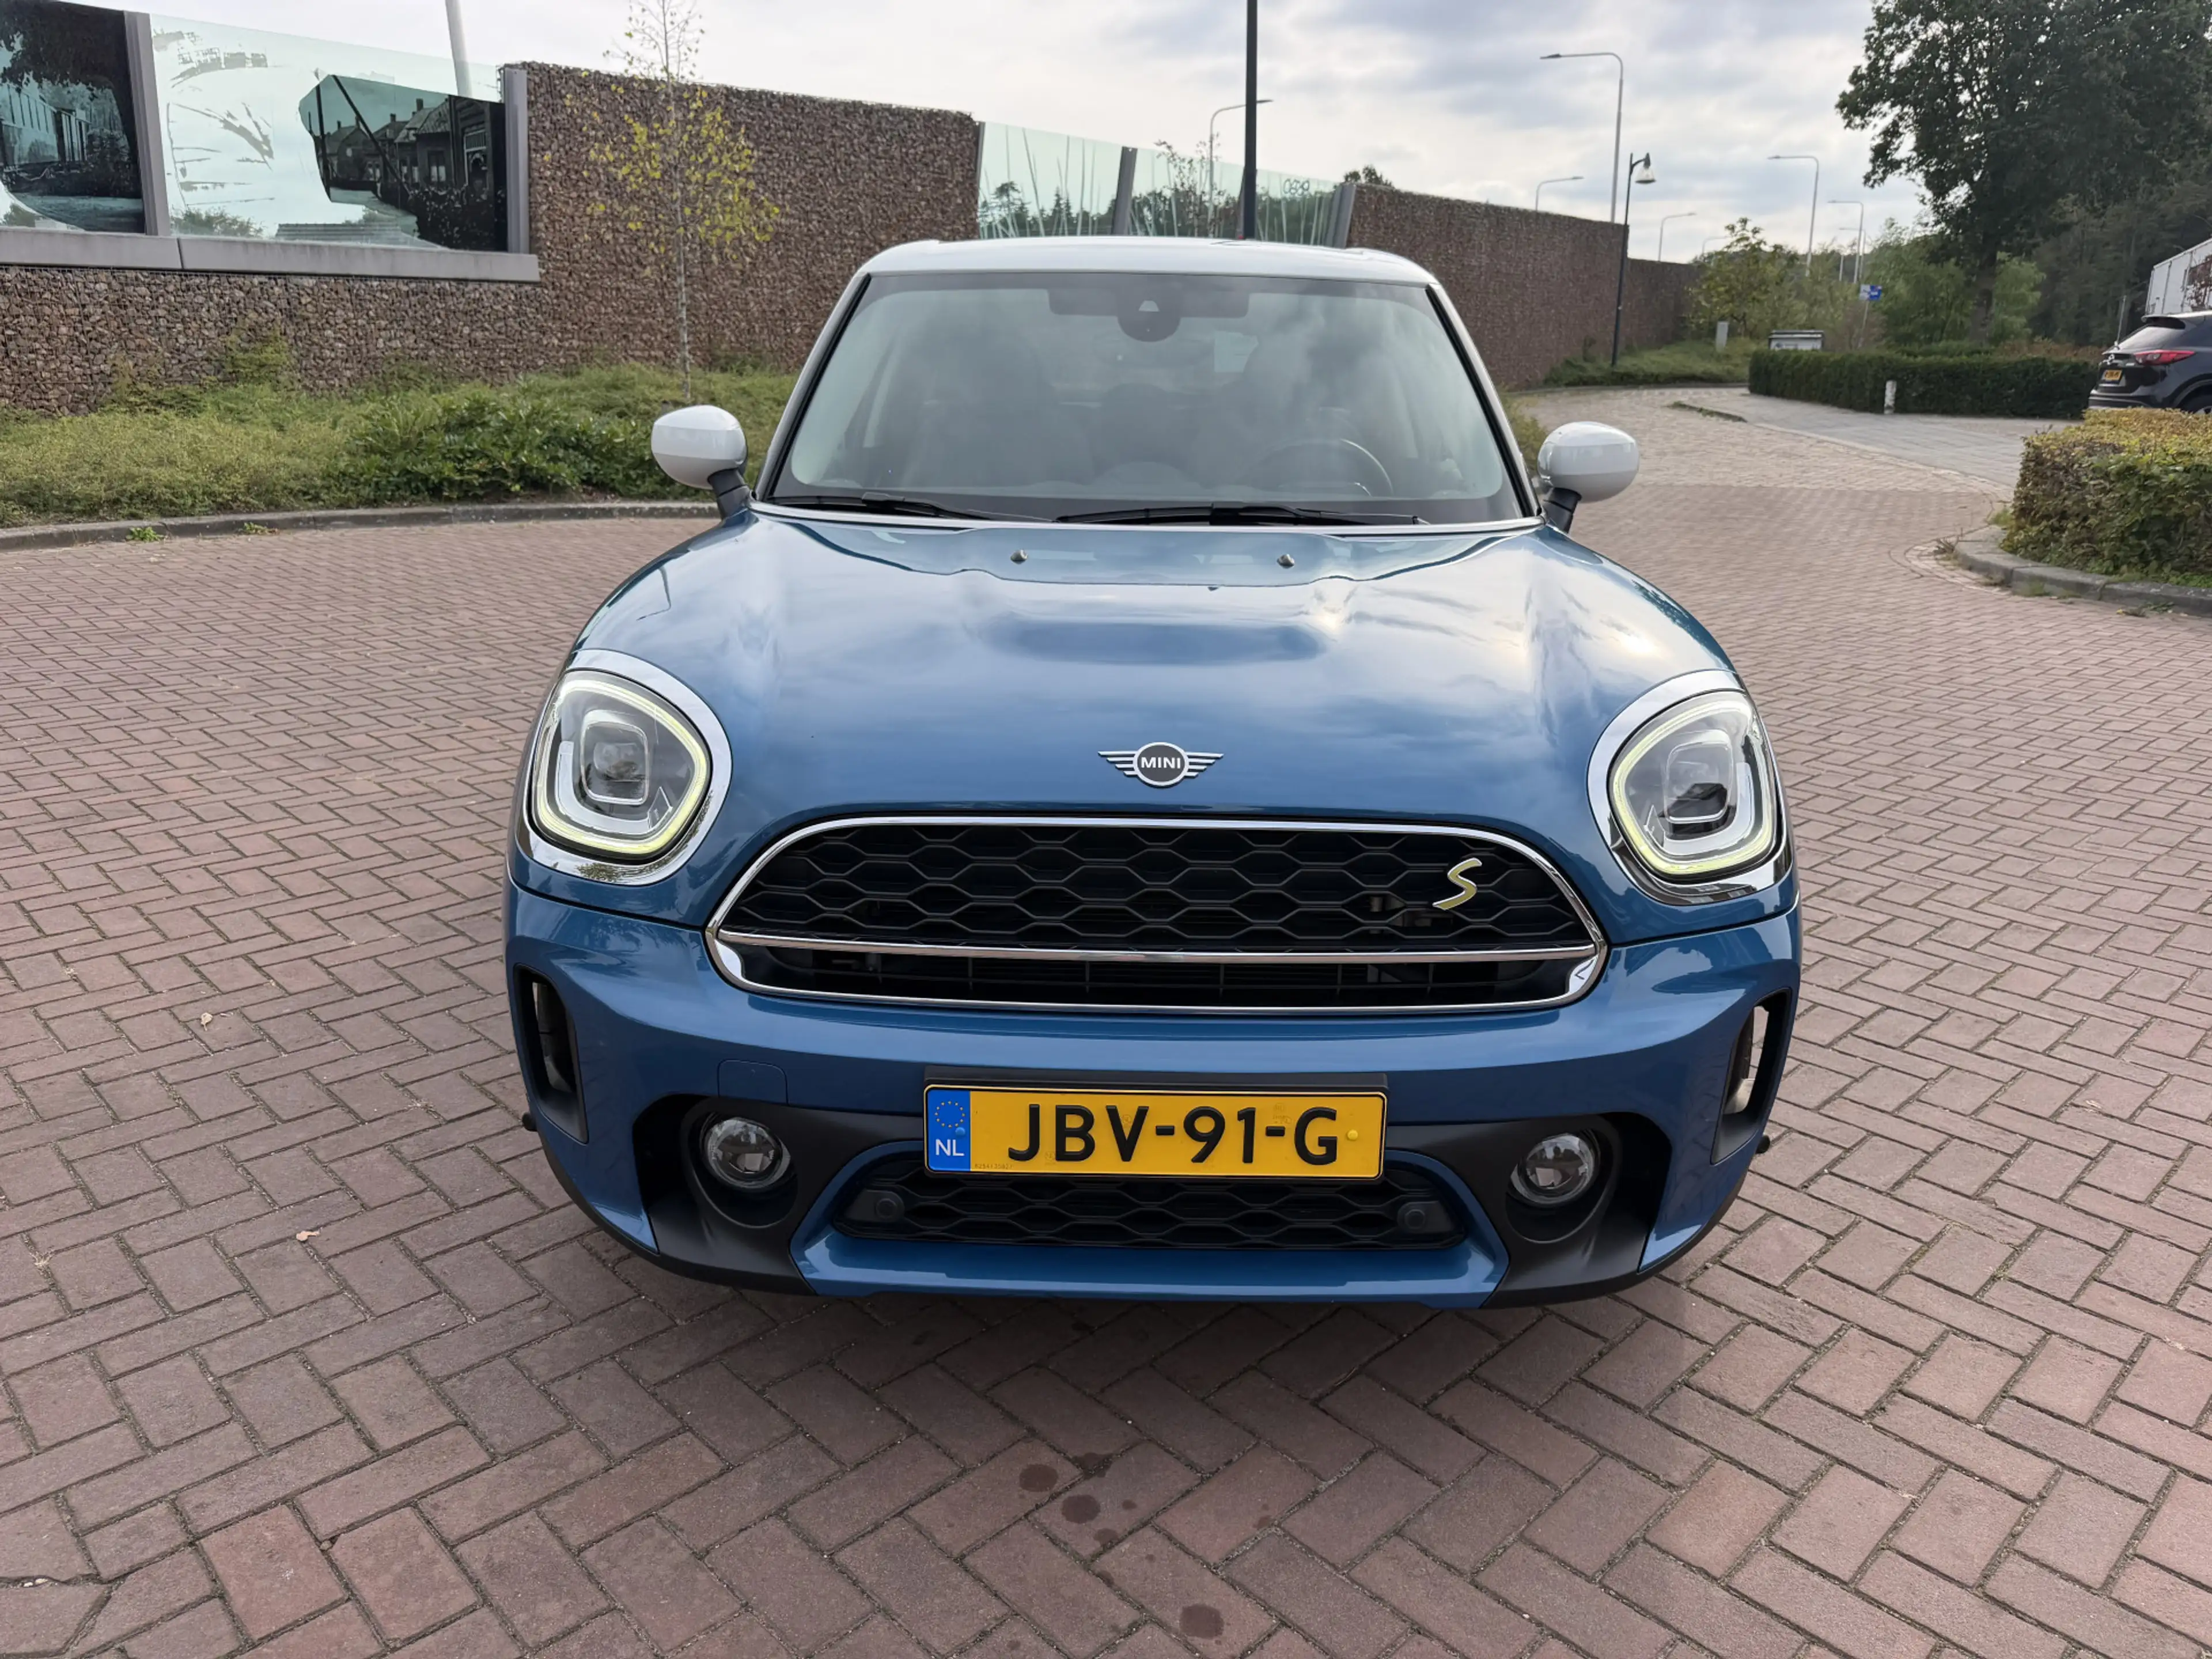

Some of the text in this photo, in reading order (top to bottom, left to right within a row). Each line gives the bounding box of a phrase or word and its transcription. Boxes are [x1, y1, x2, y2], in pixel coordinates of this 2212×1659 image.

[1141, 757, 1181, 769] MINI
[1432, 857, 1482, 911] S
[935, 1138, 965, 1157] NL
[1007, 1104, 1338, 1166] JBV-91-G
